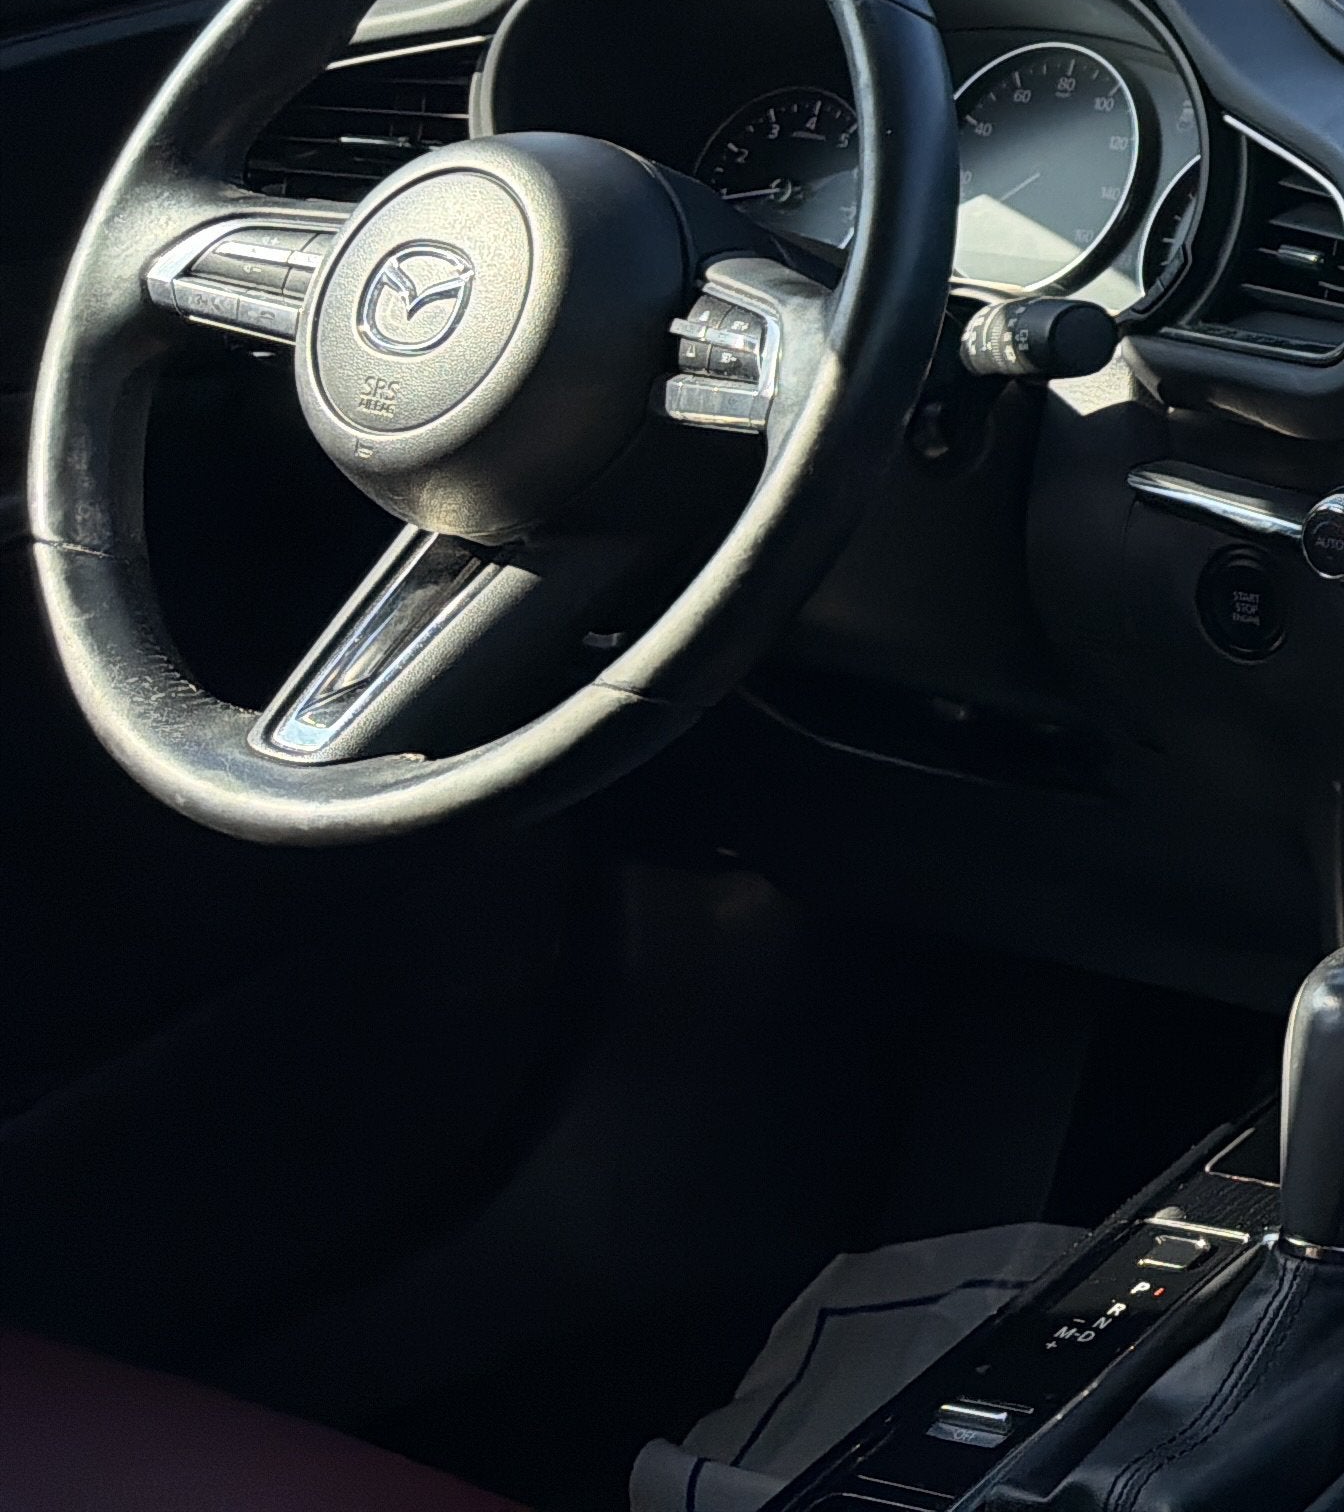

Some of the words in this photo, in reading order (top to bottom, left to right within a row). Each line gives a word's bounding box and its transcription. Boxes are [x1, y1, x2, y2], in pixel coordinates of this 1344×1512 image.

[1057, 76, 1076, 91] 80
[1013, 89, 1031, 103] 60
[1094, 97, 1115, 112] 100
[805, 116, 818, 131] 4
[974, 122, 993, 137] 40
[767, 123, 781, 140] 3
[1109, 136, 1129, 150] 120
[736, 148, 749, 164] 2
[360, 375, 400, 401] SRS
[1314, 535, 1344, 551] AUTO
[1129, 1281, 1152, 1294] P
[1106, 1302, 1127, 1317] R
[1091, 1316, 1113, 1330] N
[953, 1430, 976, 1442] OFF
